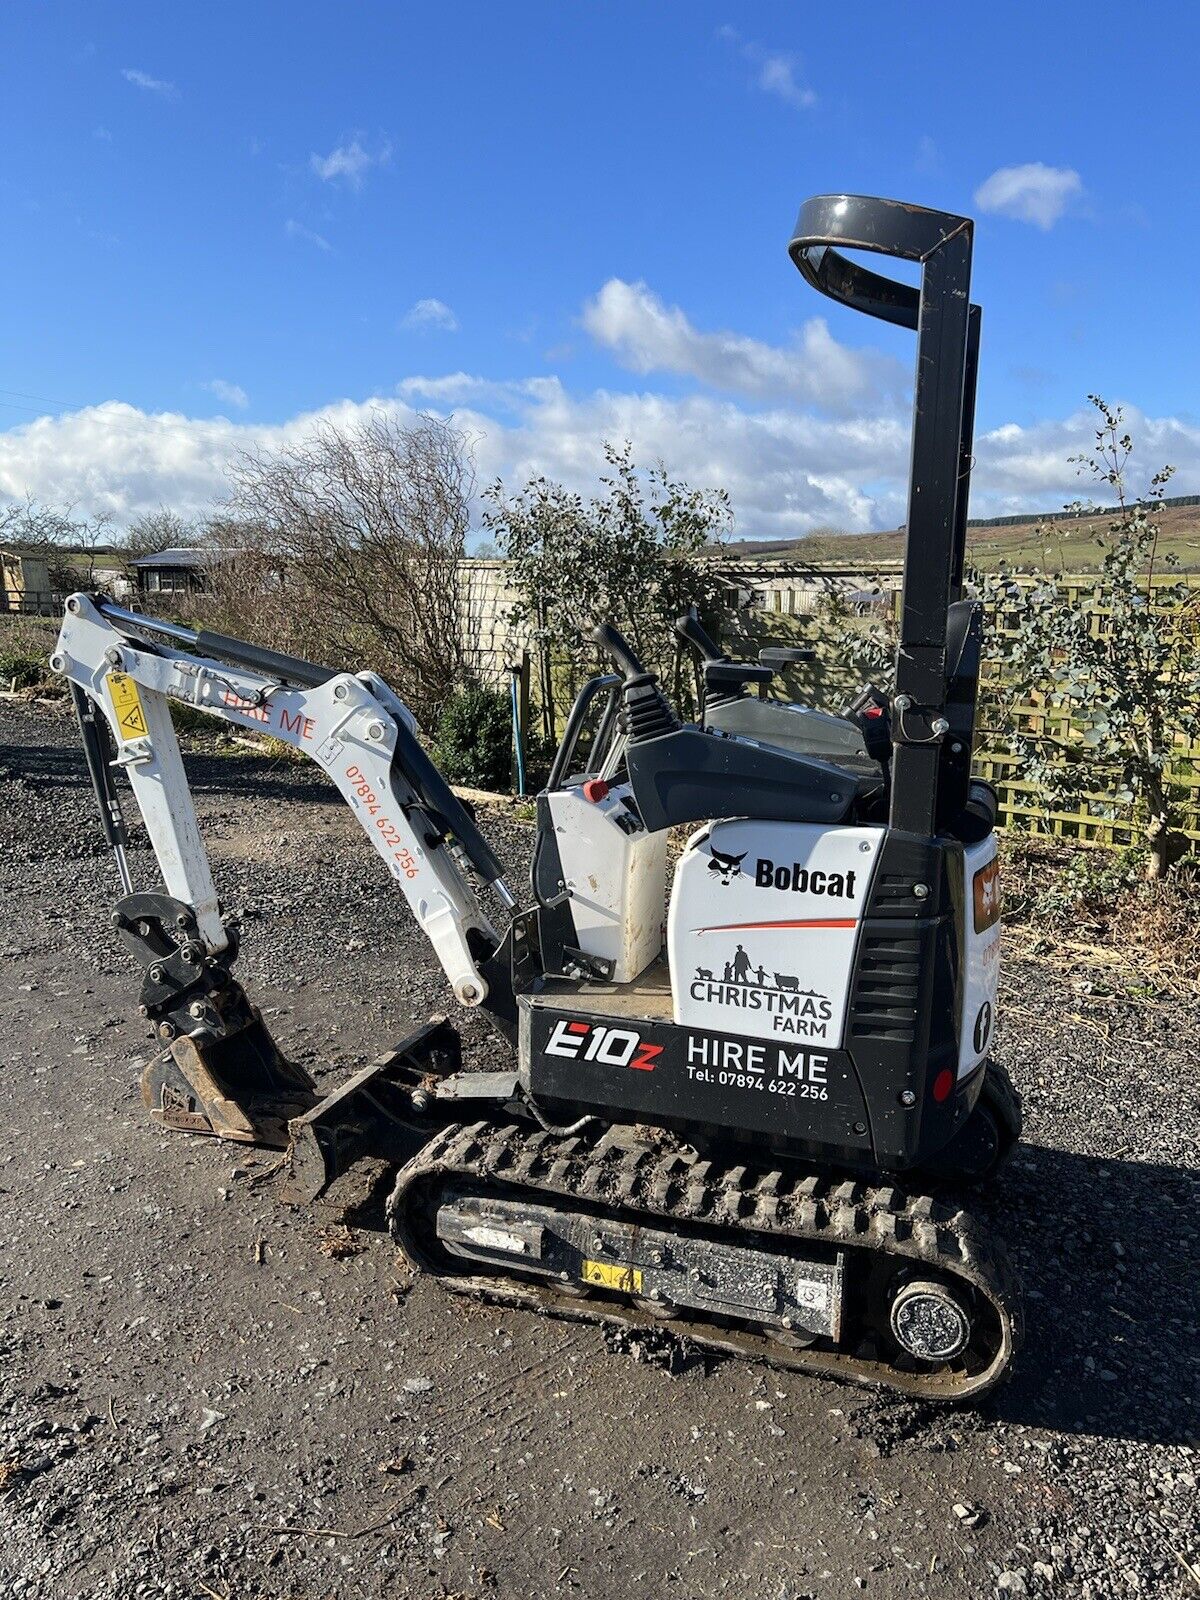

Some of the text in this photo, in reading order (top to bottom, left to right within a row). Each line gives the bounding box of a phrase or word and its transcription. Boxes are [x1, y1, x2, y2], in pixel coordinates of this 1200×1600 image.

[280, 709, 316, 740] ME
[346, 766, 419, 879] 07894 622 256
[755, 858, 856, 899] Bobcat
[690, 982, 832, 1020] CHRISTMAS
[773, 1015, 827, 1038] FARM
[688, 1036, 828, 1083] HIRE ME
[686, 1066, 829, 1101] Tel: 07894 622 256
